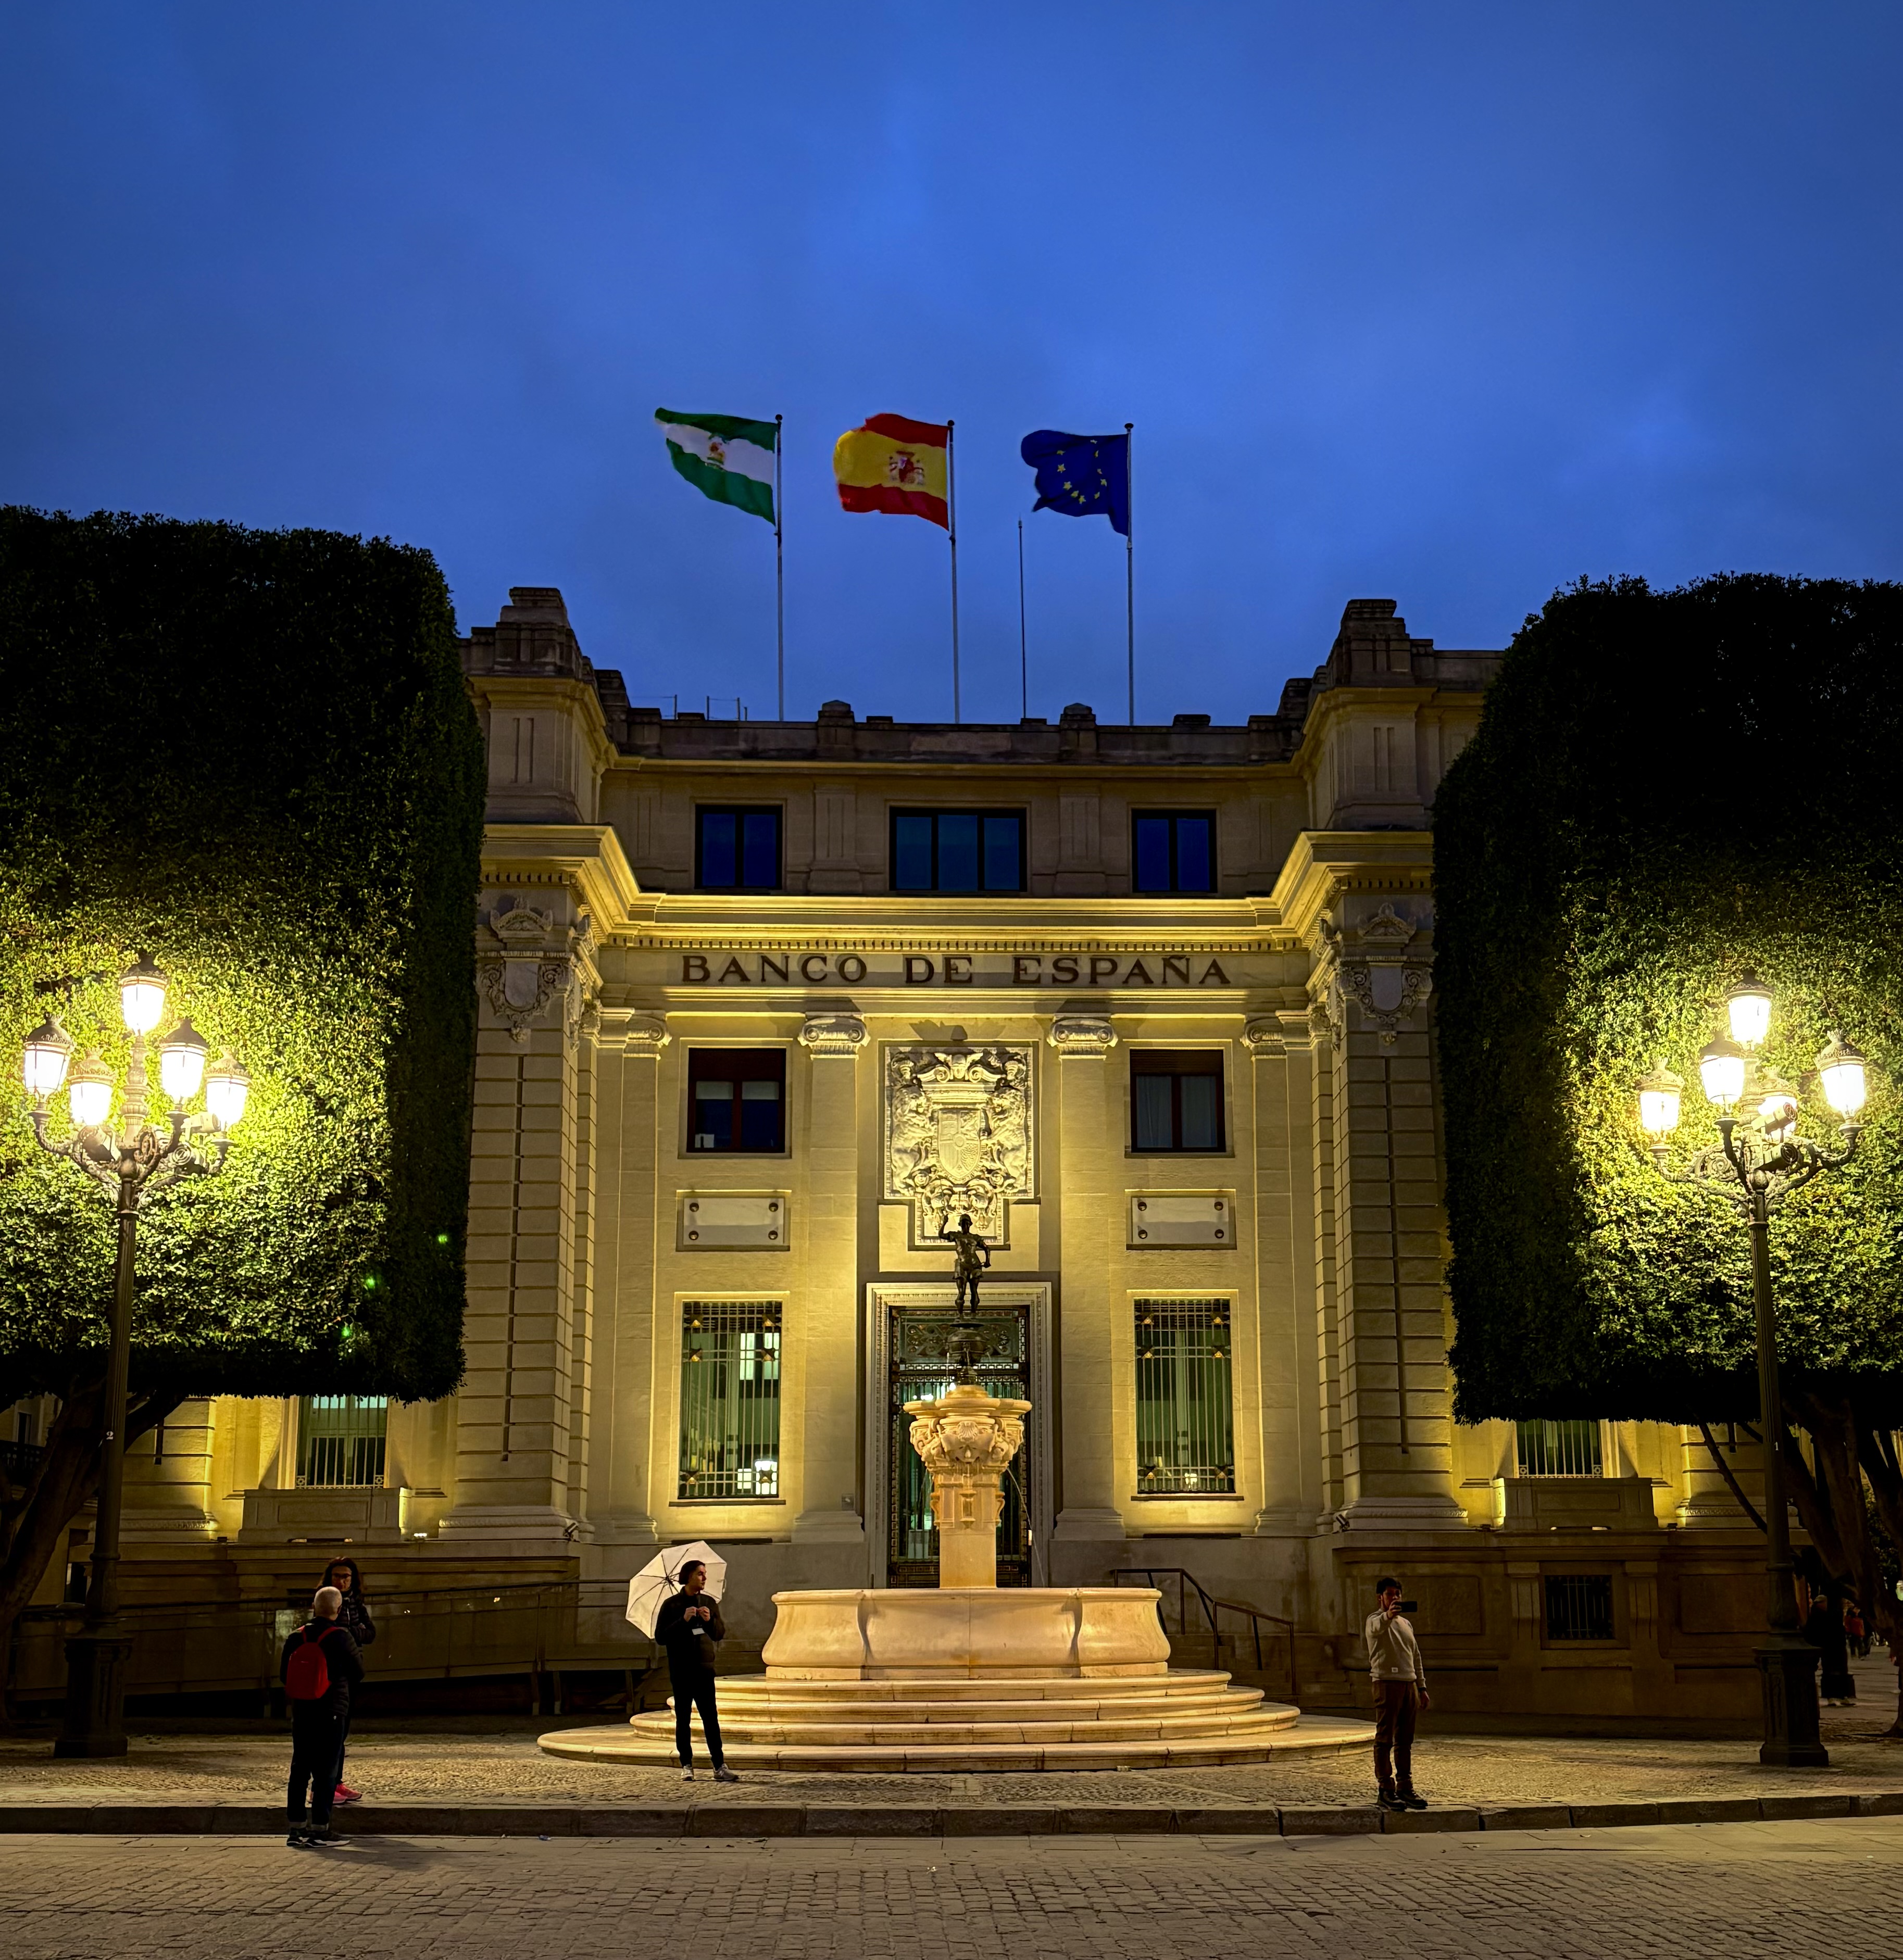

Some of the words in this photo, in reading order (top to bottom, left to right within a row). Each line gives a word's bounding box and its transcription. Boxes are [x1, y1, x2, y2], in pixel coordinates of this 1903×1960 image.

[682, 955, 867, 983] BANCO
[905, 957, 973, 984] DE
[1012, 954, 1231, 984] ESPAÑA
[106, 1431, 114, 1440] 2
[1774, 1441, 1779, 1451] 1
